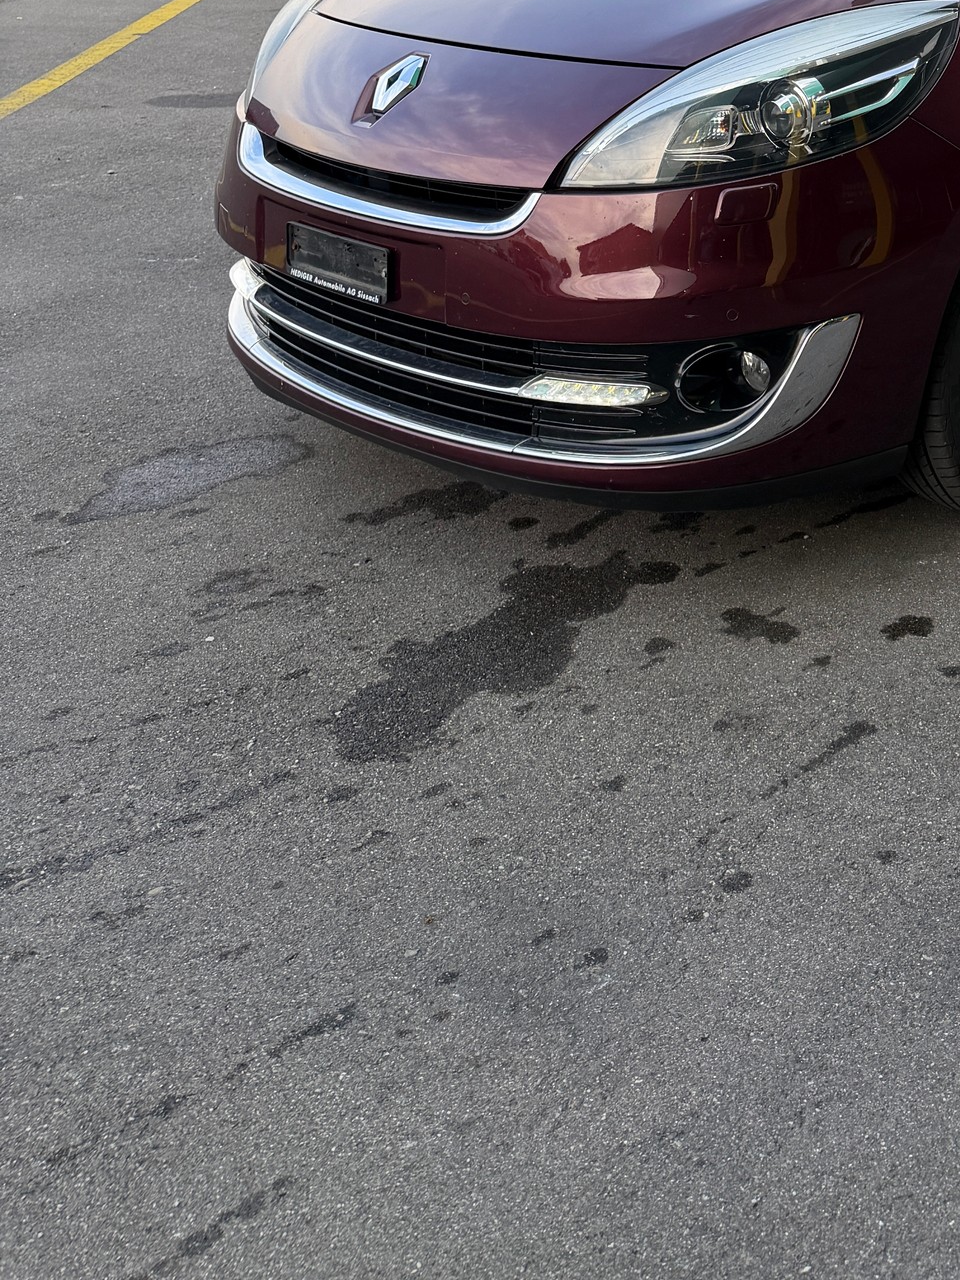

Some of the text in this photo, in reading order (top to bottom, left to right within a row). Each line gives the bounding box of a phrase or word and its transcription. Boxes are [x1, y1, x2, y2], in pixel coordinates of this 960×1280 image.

[290, 267, 380, 304] HEDIGER Automobile AG Sissach
